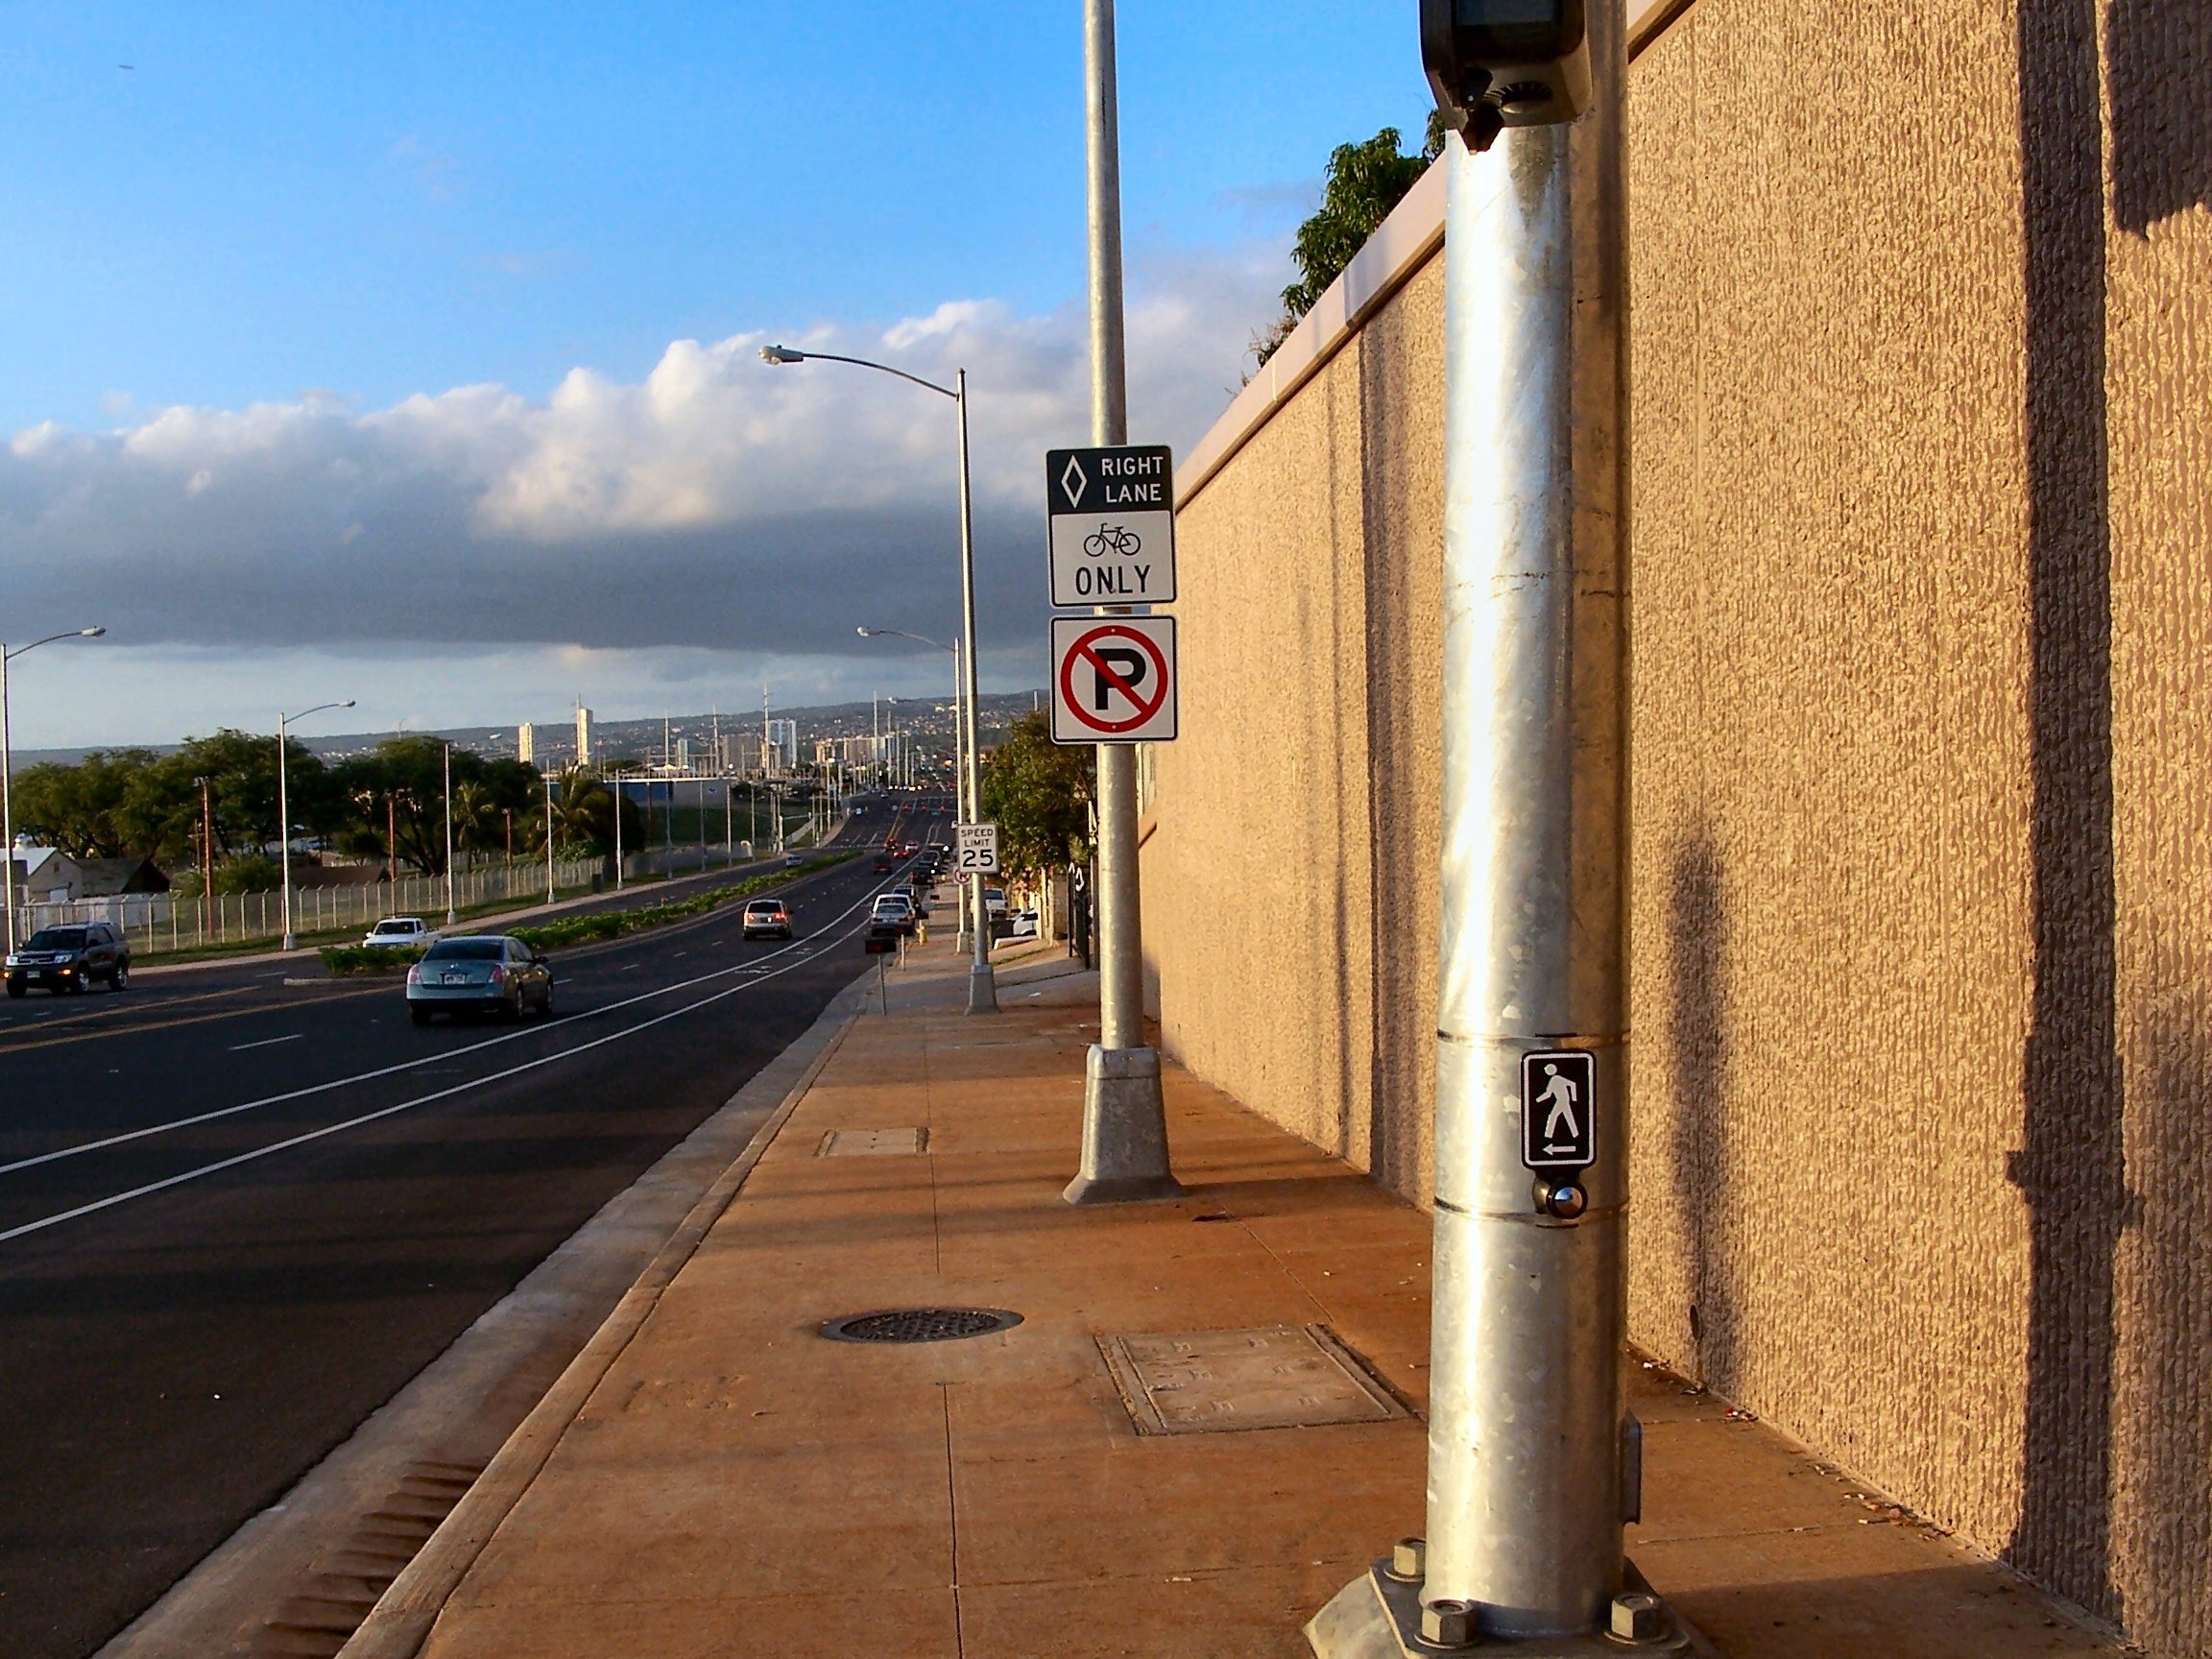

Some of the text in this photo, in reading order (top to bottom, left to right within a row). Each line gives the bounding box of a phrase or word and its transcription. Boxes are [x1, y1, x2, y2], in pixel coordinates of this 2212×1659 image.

[1101, 455, 1164, 476] RIGHT
[1105, 483, 1162, 504] LANE
[1075, 565, 1151, 596] ONLY
[1094, 648, 1146, 710] P
[961, 828, 994, 837] SPEED
[964, 838, 990, 847] LIMIT
[962, 849, 994, 867] 25
